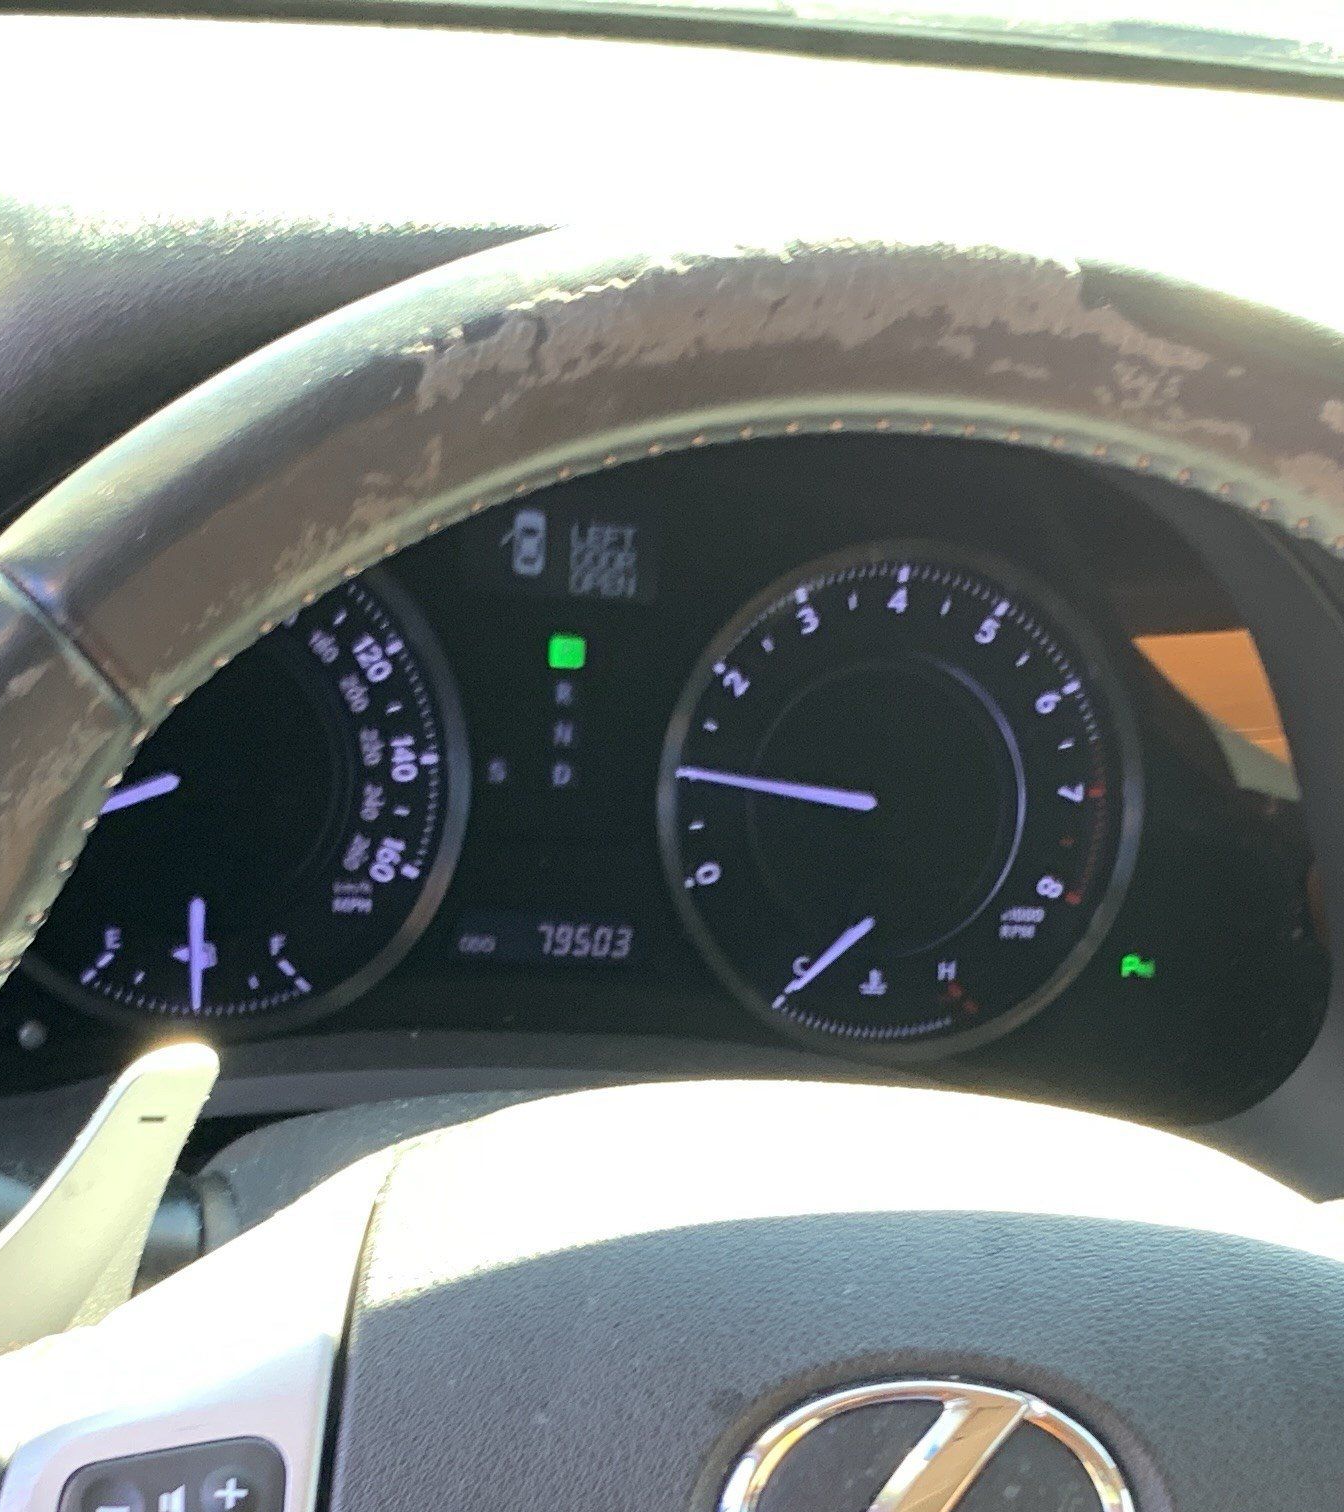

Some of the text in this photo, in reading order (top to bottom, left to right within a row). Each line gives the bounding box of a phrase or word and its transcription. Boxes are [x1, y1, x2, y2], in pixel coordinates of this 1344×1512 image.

[887, 585, 908, 614] 4
[796, 606, 819, 635] 3
[974, 617, 1000, 644] 5
[353, 632, 392, 683] 120
[722, 668, 750, 698] 2
[1034, 690, 1062, 715] 6
[391, 734, 418, 783] 140
[1057, 782, 1084, 803] 7
[369, 836, 406, 883] 160
[695, 861, 722, 883] 0
[1036, 875, 1063, 898] 8
[537, 922, 635, 959] 79503
[937, 960, 956, 981] H
